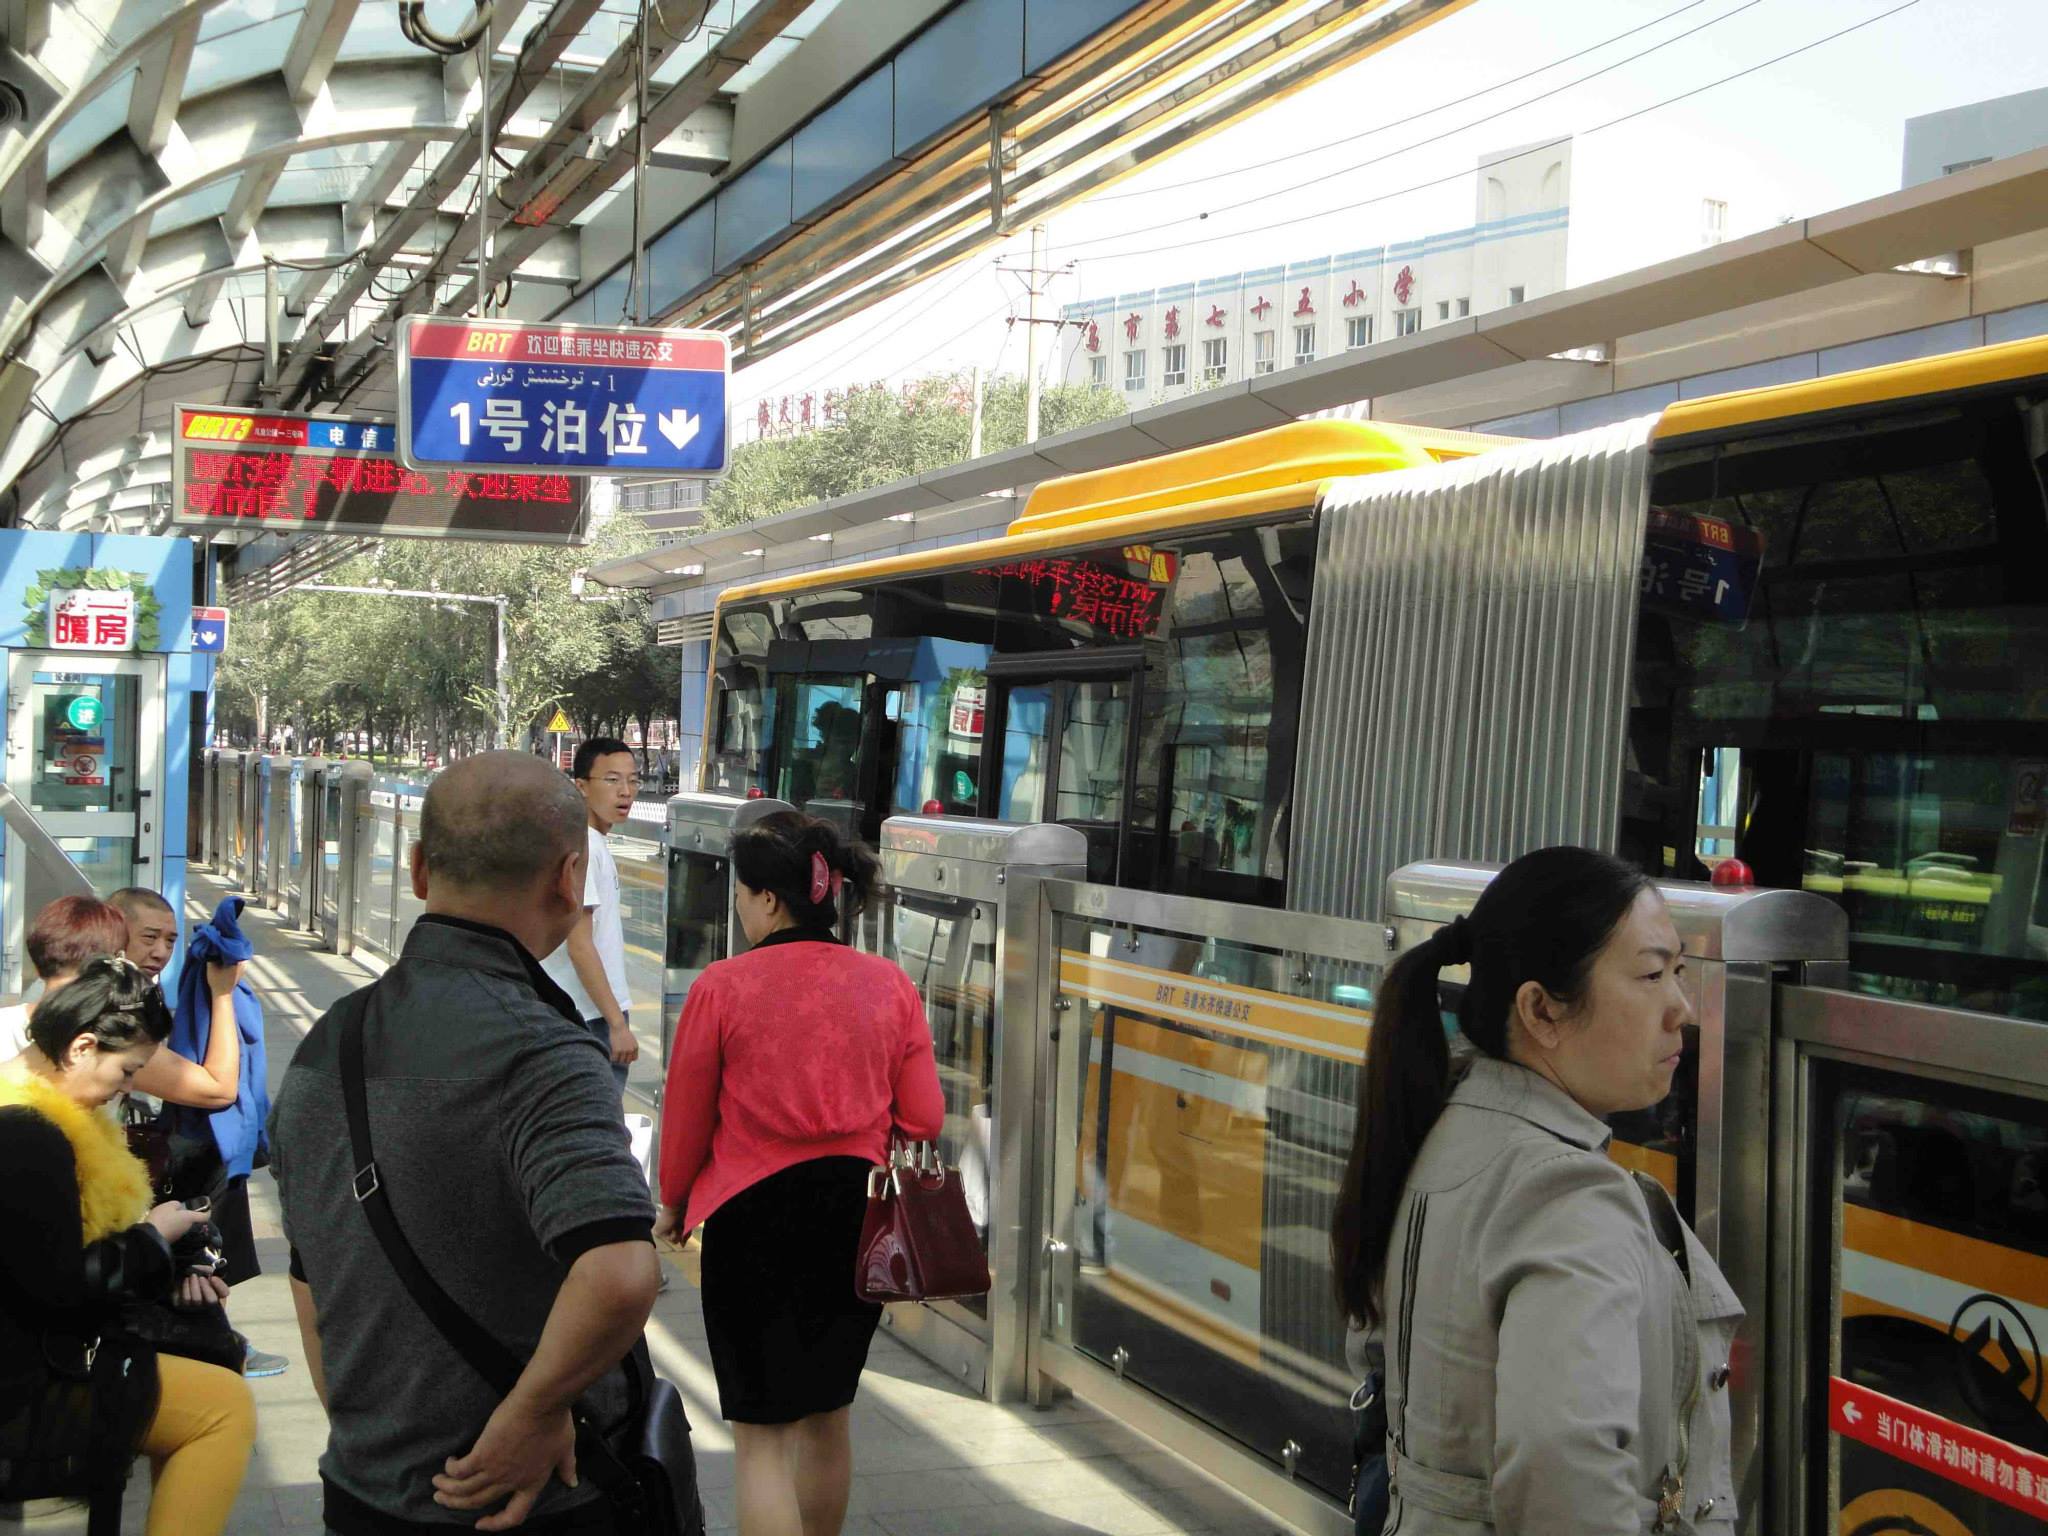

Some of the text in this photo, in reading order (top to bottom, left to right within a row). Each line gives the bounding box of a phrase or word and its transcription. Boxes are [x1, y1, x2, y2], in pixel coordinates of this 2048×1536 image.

[467, 331, 673, 362] BRT 欢迎您乘坐快速公交
[185, 415, 254, 441] BRT3
[328, 426, 396, 449] 电信
[449, 399, 649, 456] 1号泊位
[54, 612, 128, 645] 暖房
[1156, 983, 1177, 1004] BRT
